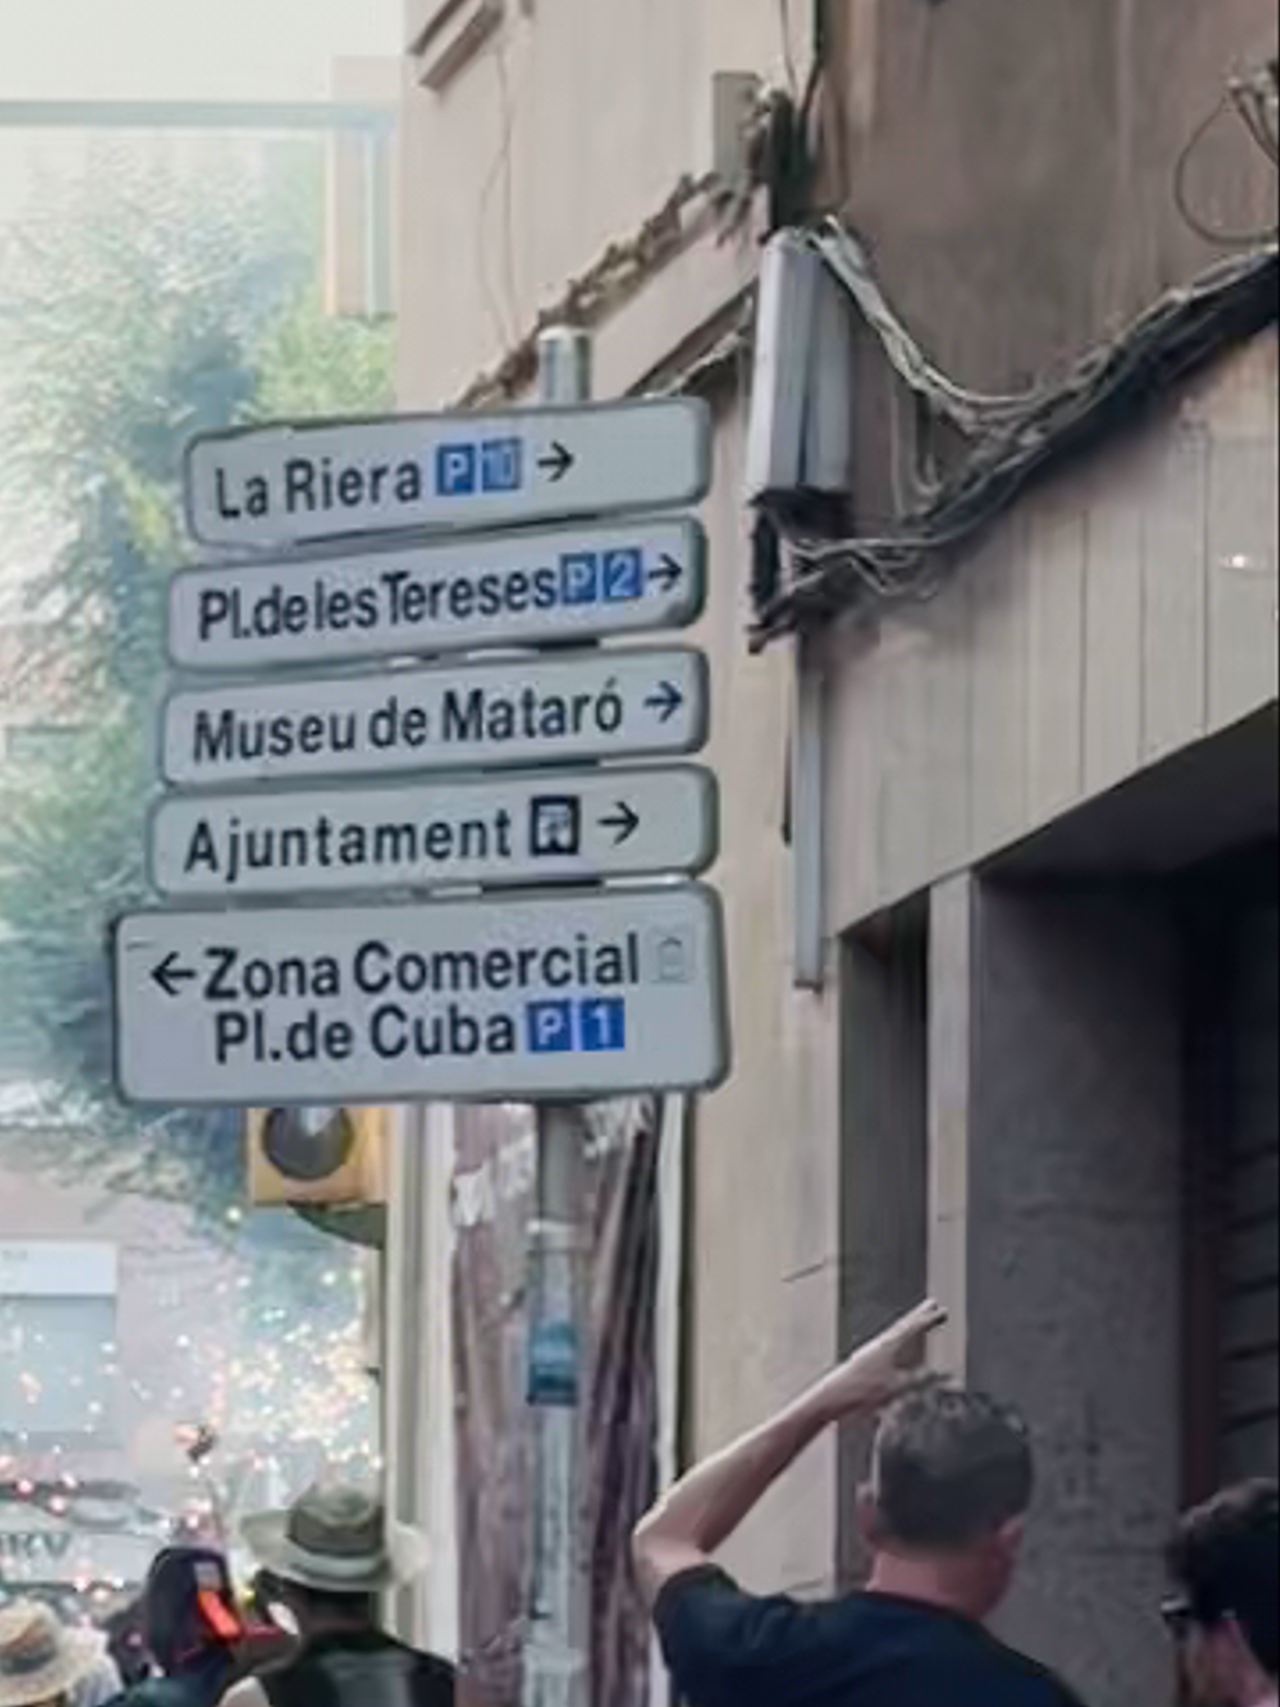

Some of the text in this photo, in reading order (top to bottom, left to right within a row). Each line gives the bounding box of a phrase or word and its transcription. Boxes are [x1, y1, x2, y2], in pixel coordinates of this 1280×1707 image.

[215, 467, 269, 519] La
[285, 457, 421, 513] Riera
[193, 677, 623, 763] Museu de Mataró
[184, 807, 512, 883] Ajuntament
[204, 931, 639, 1001] Zona Comercial
[370, 1002, 517, 1058] Cuba
